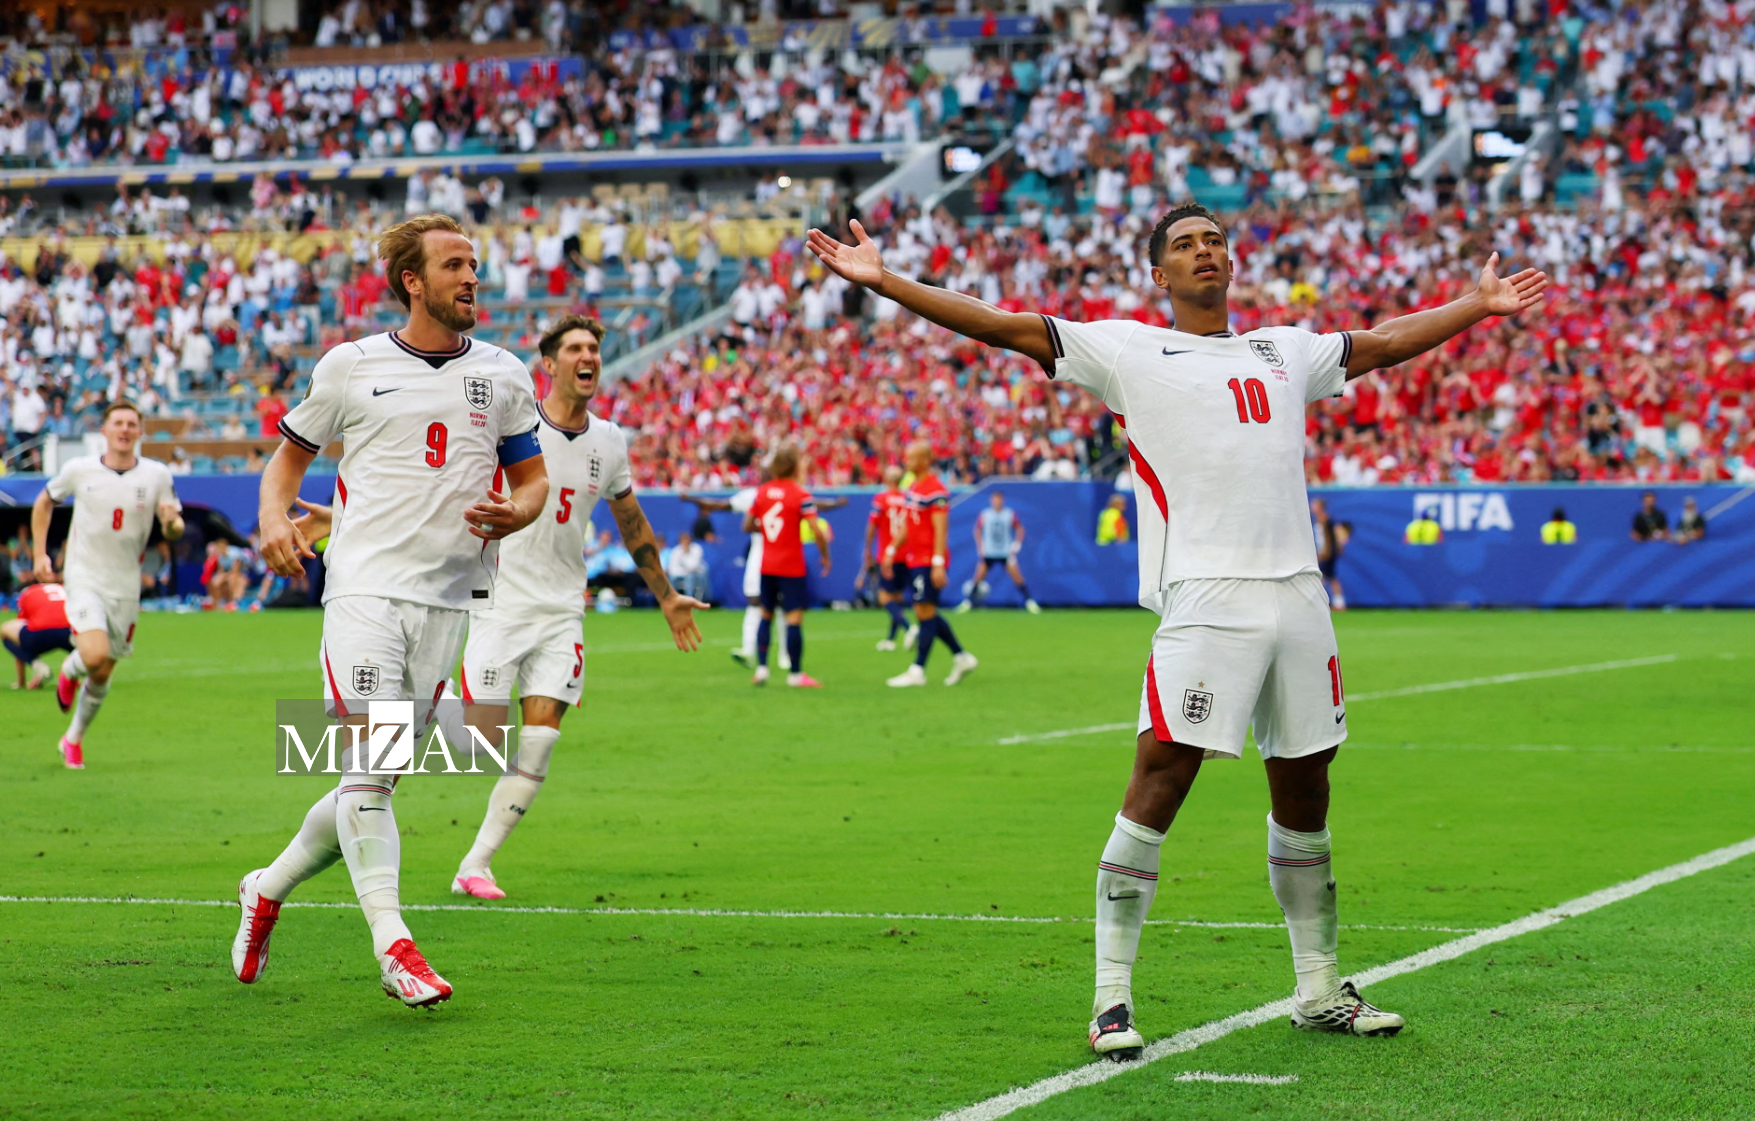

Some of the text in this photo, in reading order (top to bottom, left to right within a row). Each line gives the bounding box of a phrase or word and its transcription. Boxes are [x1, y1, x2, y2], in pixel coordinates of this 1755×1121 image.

[1228, 378, 1271, 423] 10
[426, 422, 447, 468] 9
[112, 508, 124, 530] 8
[556, 487, 575, 524] 5
[762, 501, 784, 542] 6
[1414, 493, 1513, 531] FIFA
[573, 642, 583, 678] 5
[1328, 655, 1344, 706] 1
